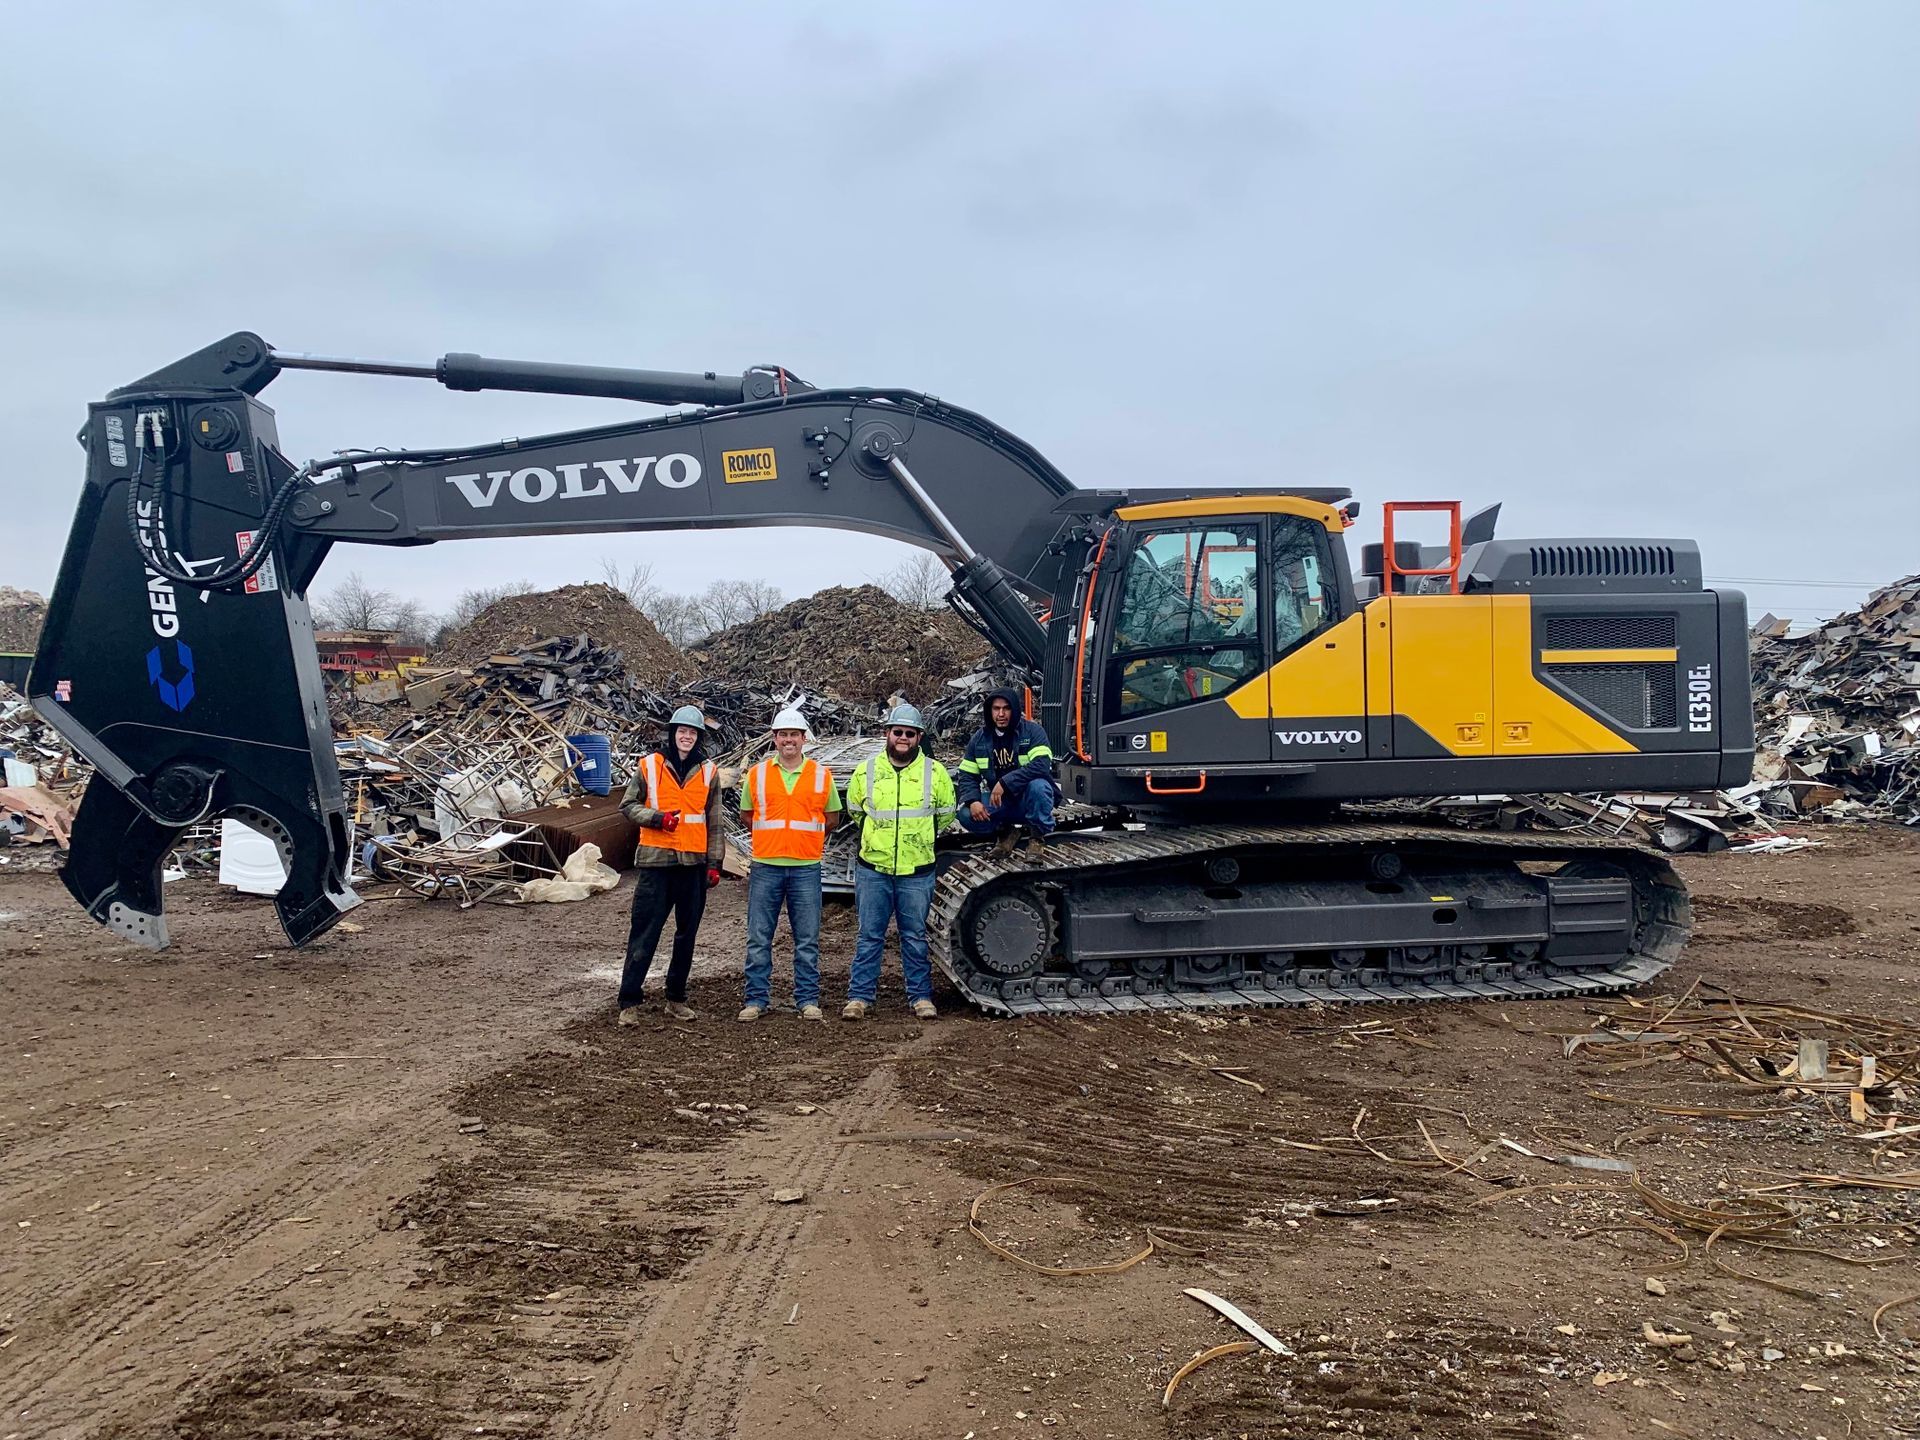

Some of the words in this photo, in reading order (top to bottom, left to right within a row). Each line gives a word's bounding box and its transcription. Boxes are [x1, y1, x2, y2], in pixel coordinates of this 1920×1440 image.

[106, 416, 123, 439] 775
[728, 453, 772, 472] ROMCO
[445, 453, 702, 508] VOLVO
[729, 471, 761, 479] EQUIPMENT
[1688, 663, 1712, 732] EC350EL
[1274, 730, 1362, 745] VOLVO
